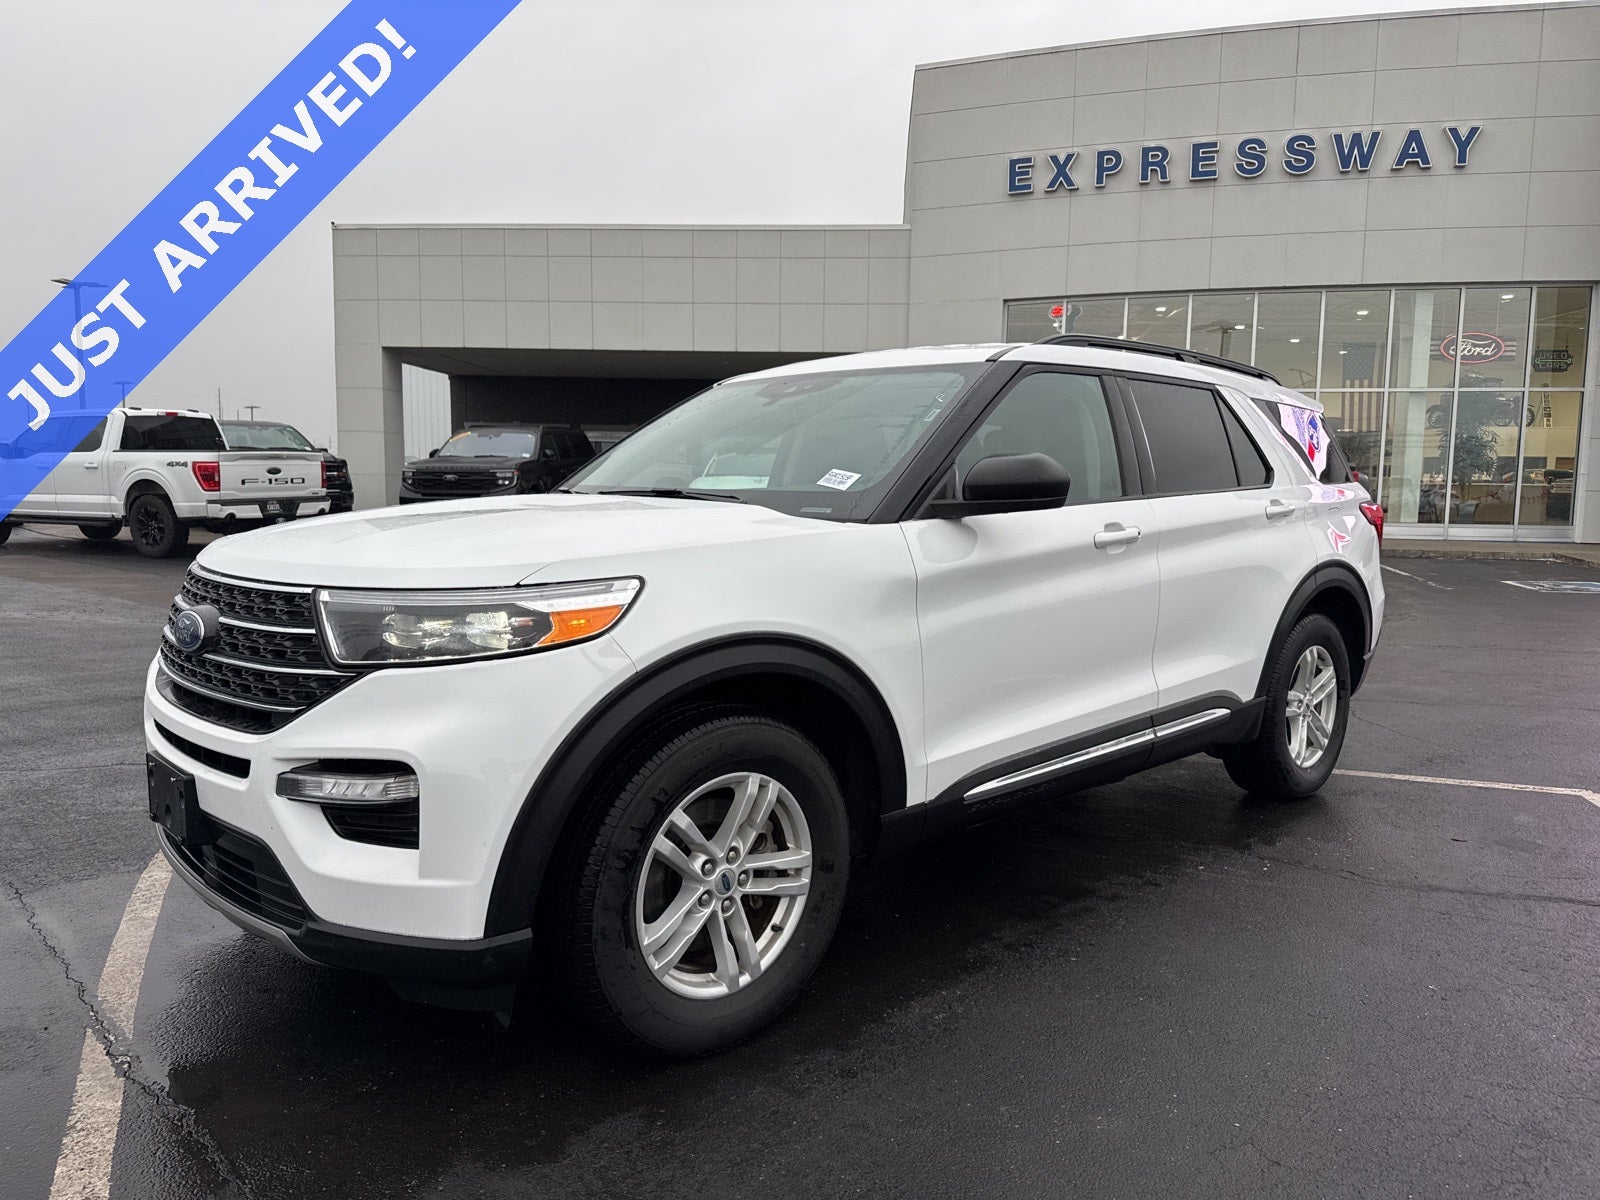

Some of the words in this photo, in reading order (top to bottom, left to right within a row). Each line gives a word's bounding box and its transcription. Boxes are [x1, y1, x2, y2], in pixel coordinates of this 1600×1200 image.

[1007, 124, 1484, 195] EXPRESSWAY
[1449, 338, 1498, 356] Ford
[1539, 351, 1568, 360] USED
[1539, 361, 1567, 369] CARS
[241, 477, 306, 486] F-150
